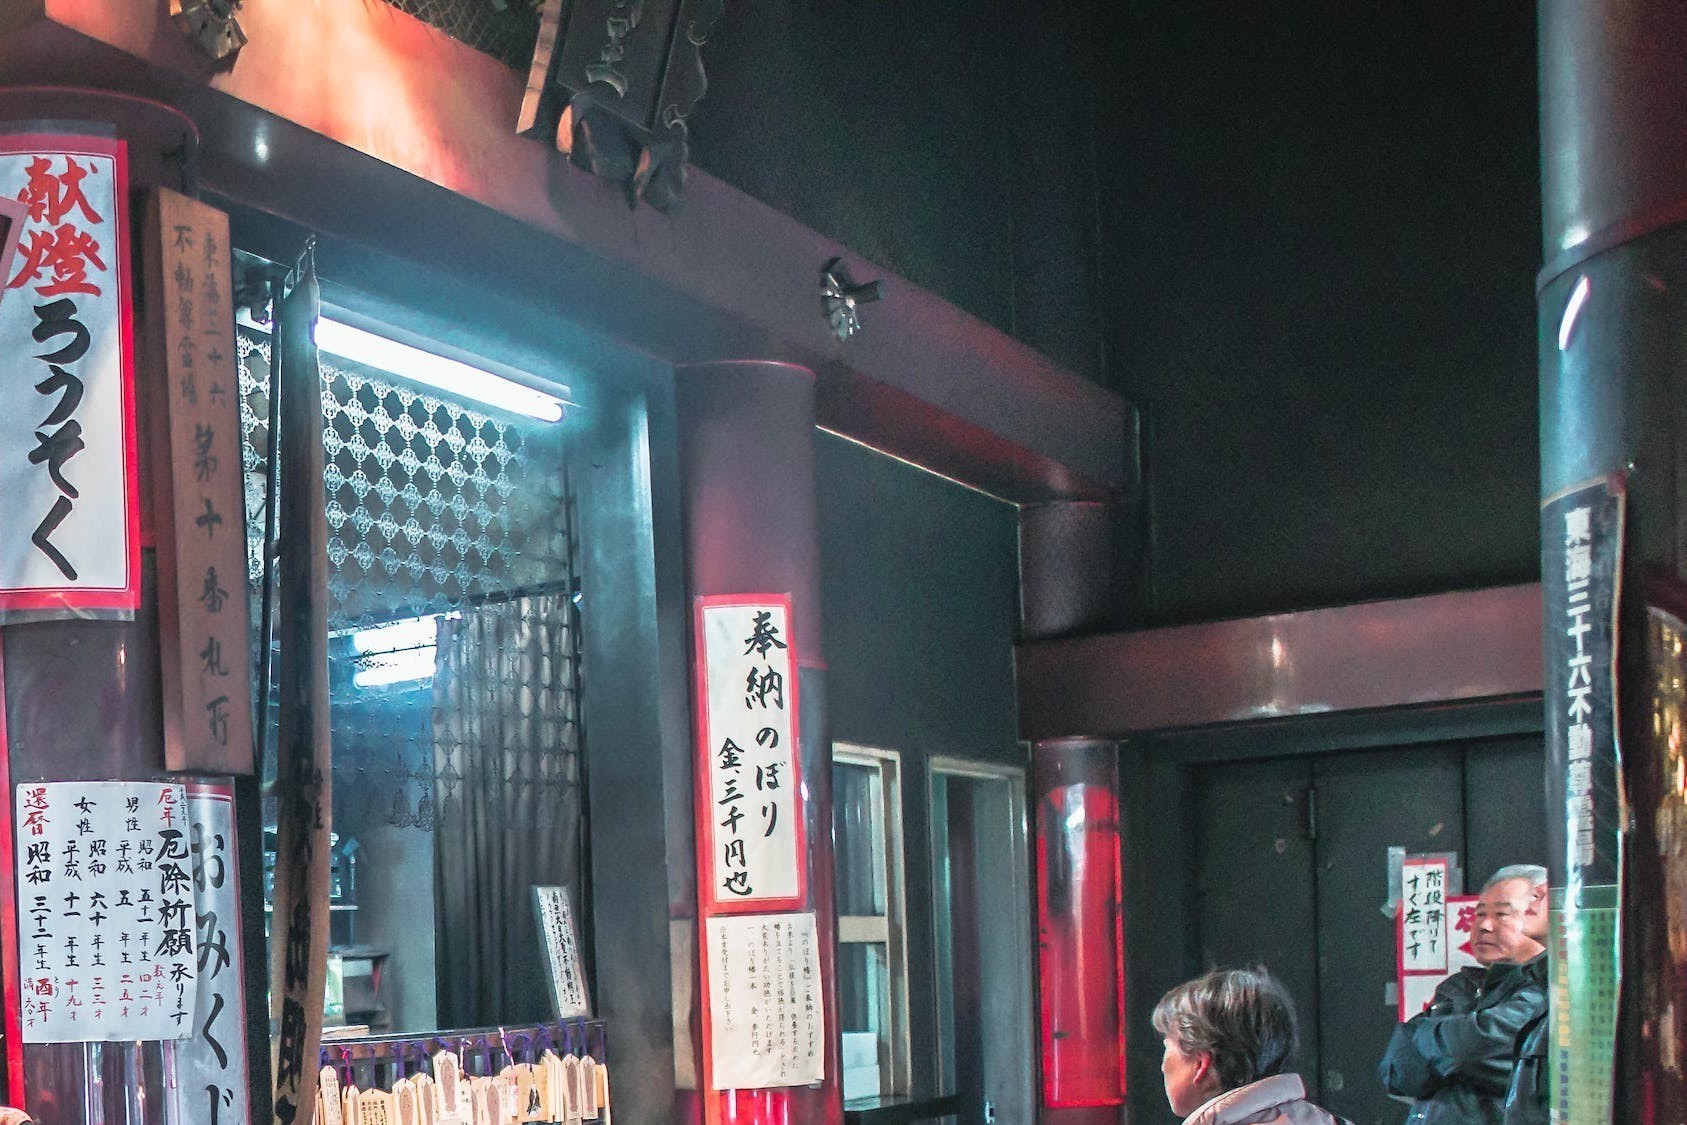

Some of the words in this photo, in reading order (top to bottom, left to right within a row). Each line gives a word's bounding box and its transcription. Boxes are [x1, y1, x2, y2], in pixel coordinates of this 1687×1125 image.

[743, 610, 789, 838] 奉納のぼり
[73, 796, 97, 837] 女性
[124, 796, 142, 833] 男性
[1404, 874, 1424, 961] すぐ左です
